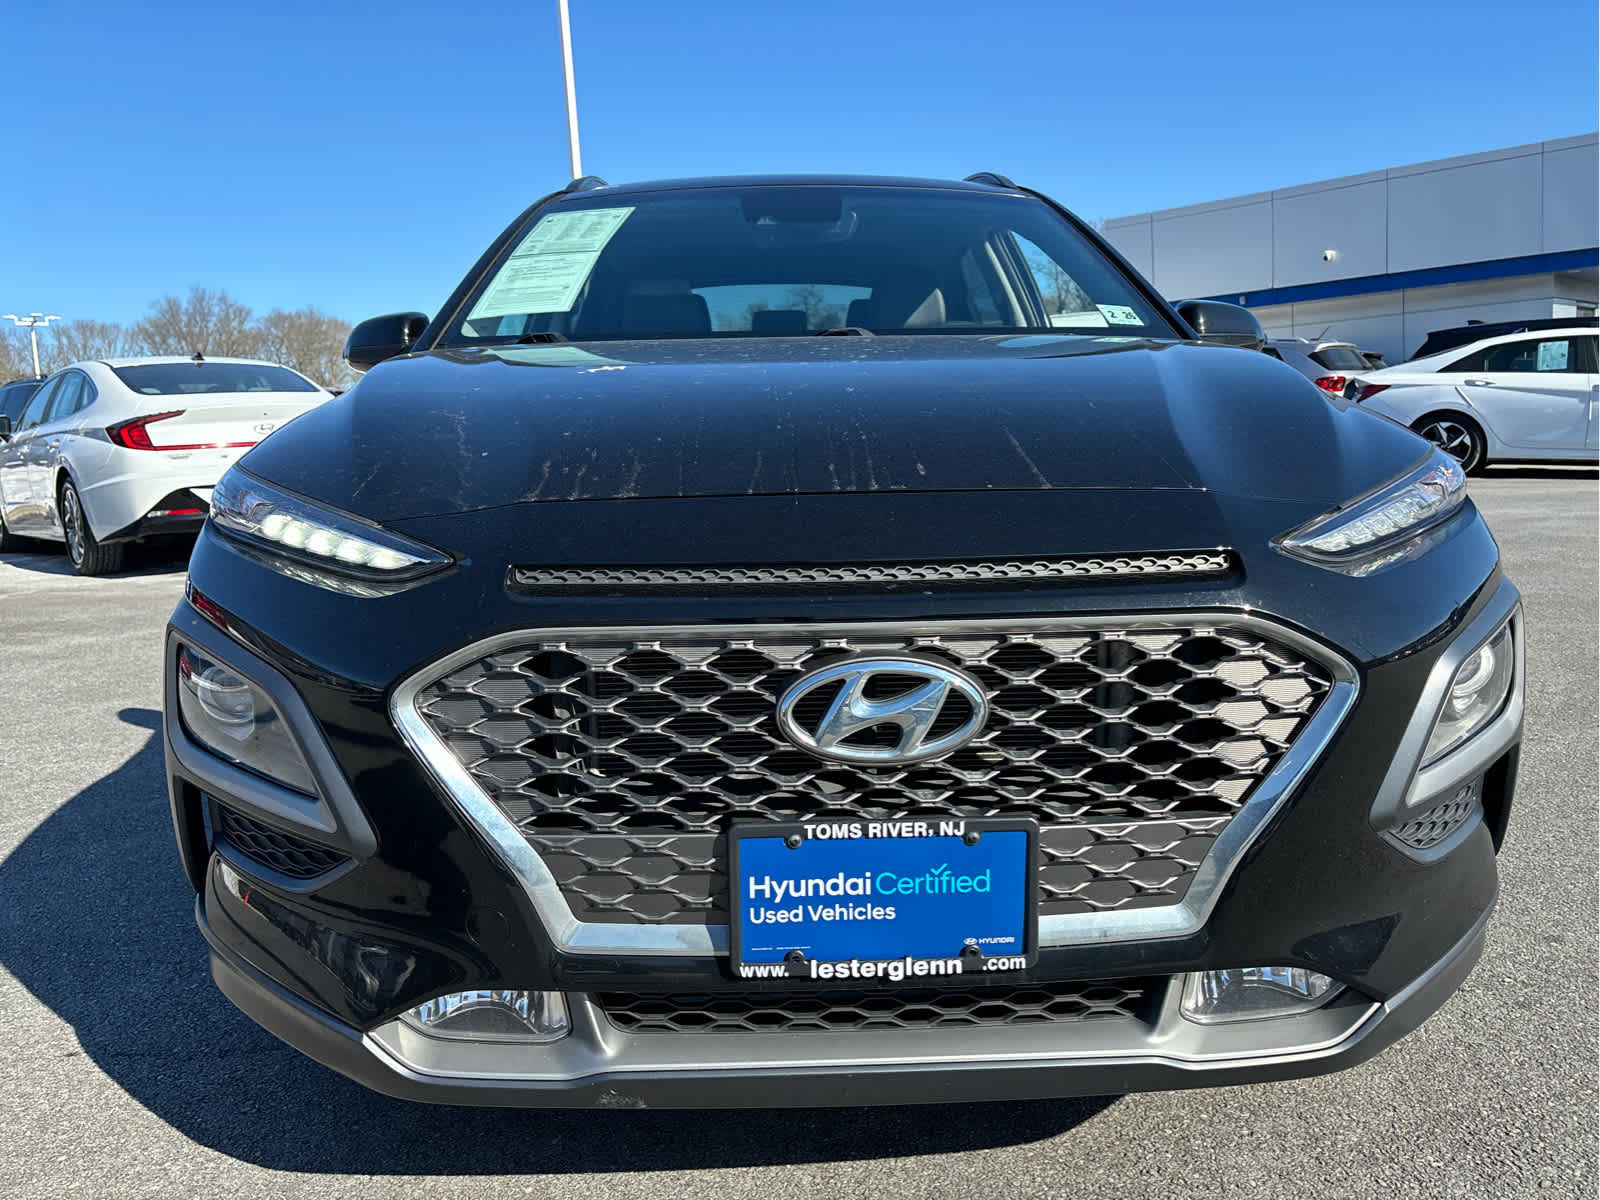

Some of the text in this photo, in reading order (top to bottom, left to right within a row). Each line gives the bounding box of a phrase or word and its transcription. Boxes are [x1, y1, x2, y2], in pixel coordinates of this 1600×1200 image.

[803, 820, 966, 840] TOMS RIVER, NJ
[748, 864, 991, 904] Hyundai Certified
[749, 902, 897, 924] Used Vehicles
[978, 936, 1015, 945] HYUNDAI
[739, 956, 1027, 982] www. lesterglenn .com
